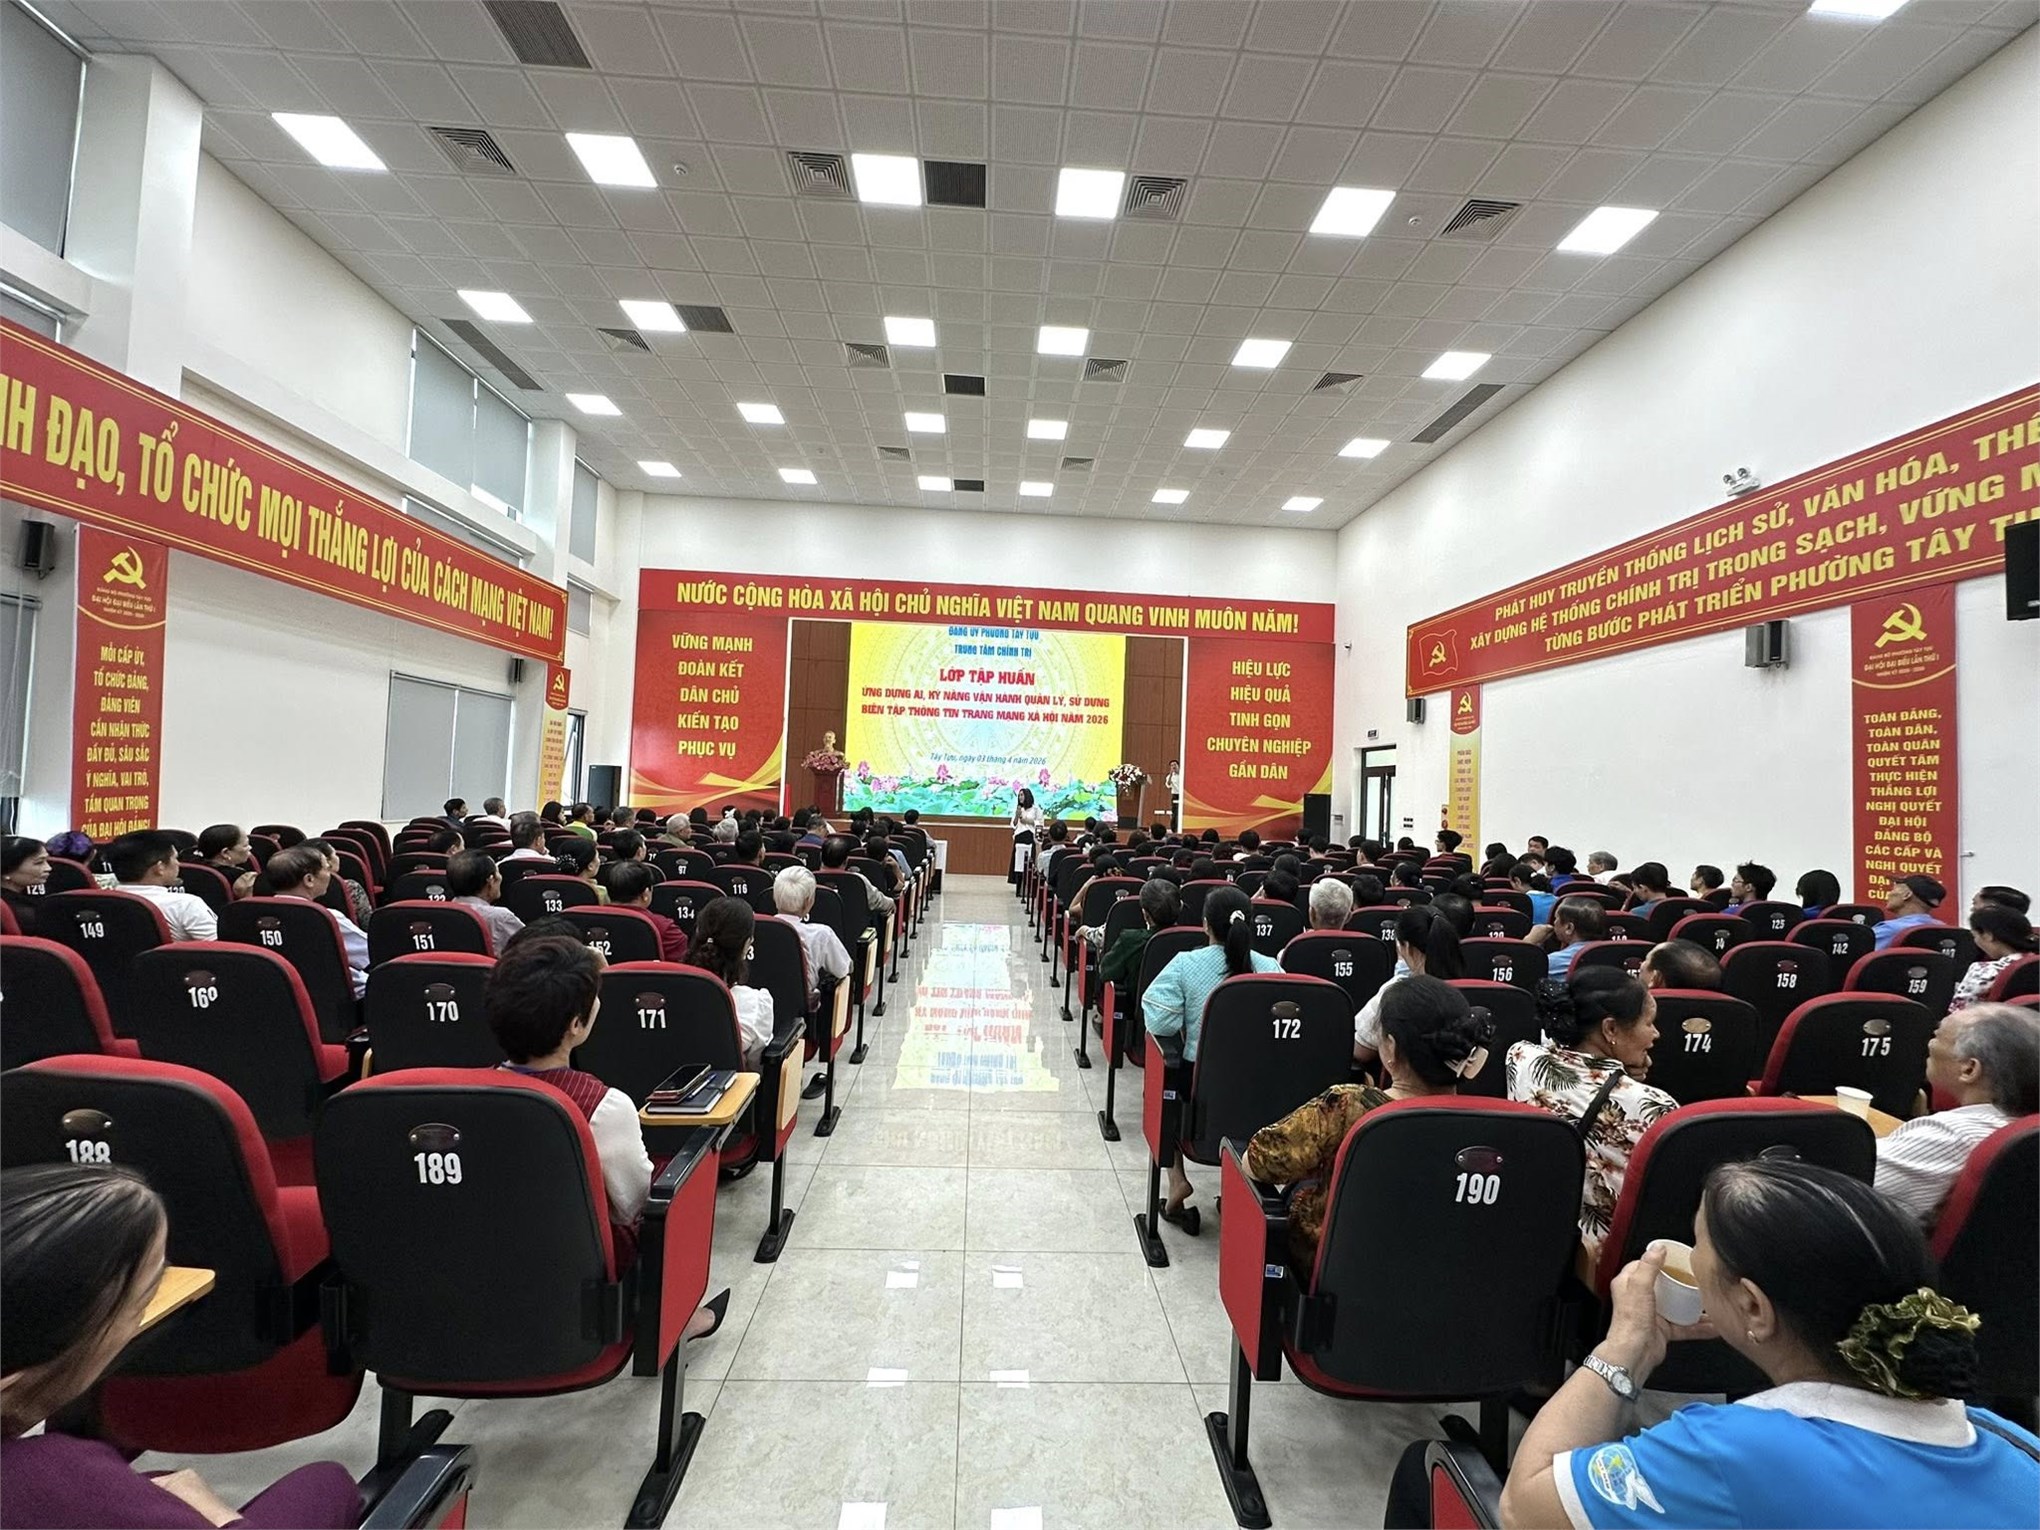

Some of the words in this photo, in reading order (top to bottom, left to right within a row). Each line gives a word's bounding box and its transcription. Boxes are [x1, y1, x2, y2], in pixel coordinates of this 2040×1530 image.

[46, 394, 125, 496] ĐẠO,
[139, 420, 179, 503] TỔ
[182, 452, 253, 532] CHỨC
[258, 484, 303, 559] MỌI
[308, 499, 369, 575] THẮNG
[371, 533, 398, 593] LỢI
[401, 537, 430, 598] CỦA
[433, 556, 469, 612] CÁCH
[470, 576, 505, 627] MẠNG
[506, 587, 528, 638] VIỆT
[528, 600, 554, 641] NAM!
[1495, 598, 1527, 622] PHÁT
[1529, 588, 1555, 610] HUY
[1559, 565, 1619, 600] TRUYỀN
[1623, 542, 1687, 578] THỐNG
[1693, 521, 1744, 555] LỊCH
[1751, 501, 1794, 536] SỬ,
[1803, 479, 1865, 518] VĂN
[1875, 451, 1960, 495] HÓA,
[1470, 631, 1492, 650] XÂY
[1494, 621, 1527, 644] DỰNG
[1530, 613, 1548, 633] HỆ
[1551, 598, 1601, 626] THỐNG
[1606, 579, 1662, 611] CHÍNH
[1667, 567, 1699, 593] TRỊ
[1706, 541, 1786, 581] TRONG
[1795, 512, 1888, 555] SẠCH,
[1898, 474, 2005, 525] VỮNG
[1545, 630, 1583, 652] TỪNG
[1587, 614, 1633, 642] BƯỚC
[1637, 600, 1688, 630] PHÁT
[1694, 577, 1762, 615] TRIỂN
[1770, 546, 1895, 597] PHƯỜNG
[1905, 523, 1977, 563] TÂY
[677, 580, 727, 605] NƯỚC
[733, 581, 783, 611] CỘNG
[788, 583, 825, 610] HÒA
[829, 586, 854, 611] XÃ
[859, 587, 889, 617] HỘI
[895, 588, 931, 615] CHỦ
[936, 592, 991, 617] NGHĨA
[996, 594, 1034, 624] VIỆT
[1038, 601, 1079, 622] NAM
[1085, 602, 1143, 625] QUANG
[1148, 606, 1190, 628] VINH
[1195, 606, 1247, 631] MUÔN
[1251, 608, 1299, 634] NĂM!
[672, 632, 708, 650] VỮNG
[712, 636, 753, 654] MẠNH
[954, 644, 977, 655] TRUNG
[678, 659, 715, 677] ĐOÀN
[719, 658, 744, 678] KẾT
[1232, 658, 1262, 679] HIỆU
[1266, 662, 1291, 680] LỰC
[968, 667, 995, 687] TẬP
[998, 667, 1035, 686] HUẤN
[680, 685, 708, 703] DÂN
[712, 685, 739, 704] CHỦ
[1230, 684, 1260, 704] HIỆU
[1264, 684, 1291, 704] QUẢ
[677, 710, 710, 729] KIẾN
[713, 715, 739, 733] TẠO
[942, 708, 959, 718] TIN
[961, 709, 994, 719] TRANG
[1086, 714, 1109, 725] 2026
[1229, 712, 1260, 727] TINH
[1263, 713, 1291, 731] GỌN
[1864, 712, 1897, 724] TOÀN
[1868, 726, 1901, 738] TOÀN
[678, 740, 715, 759] PHỤC
[718, 742, 736, 760] VỤ
[1207, 735, 1259, 753] CHUYÊN
[1263, 738, 1312, 757] NGHIỆP
[1866, 741, 1899, 753] TOÀN
[1903, 739, 1940, 751] QUÂN
[1229, 759, 1257, 778] GẦN
[1260, 762, 1288, 779] DÂN
[1867, 754, 1907, 768] QUYẾT
[1909, 754, 1940, 765] TÂM
[1869, 771, 1902, 783] THỰC
[1905, 768, 1938, 783] HIỆN
[1869, 783, 1912, 796] THẮNG
[1916, 785, 1937, 798] LỢI
[103, 796, 124, 814] QUAN
[1865, 801, 1896, 813] NGHỊ
[1900, 798, 1943, 812] QUYẾT
[1878, 816, 1900, 828] ĐẠI
[1904, 815, 1927, 829] HỘI
[1874, 828, 1910, 842] ĐẢNG
[1913, 831, 1932, 845] BỘ
[1865, 844, 1890, 856] CÁC
[1893, 844, 1920, 857] CẤP
[1924, 847, 1943, 859] VÀ
[678, 865, 687, 874] 97
[1865, 859, 1896, 873] NGHỊ
[1900, 861, 1942, 875] QUYẾT
[27, 884, 45, 895] 129
[733, 884, 747, 894] 116
[545, 899, 562, 912] 133
[80, 922, 104, 938] 149
[1256, 924, 1273, 936] 137
[1771, 919, 1785, 930] 125
[260, 930, 282, 946] 150
[413, 934, 434, 950] 151
[1832, 943, 1848, 955] 142
[1334, 962, 1353, 977] 155
[1492, 966, 1513, 982] 156
[1777, 972, 1797, 988] 158
[1908, 979, 1928, 993] 159
[188, 986, 218, 1008] 160
[426, 1001, 459, 1022] 170
[637, 1008, 666, 1029] 171
[1272, 1018, 1301, 1039] 172
[1684, 1033, 1711, 1053] 174
[1862, 1037, 1891, 1057] 175
[65, 1139, 111, 1163] 188
[414, 1152, 462, 1184] 189
[1455, 1172, 1500, 1204] 190
